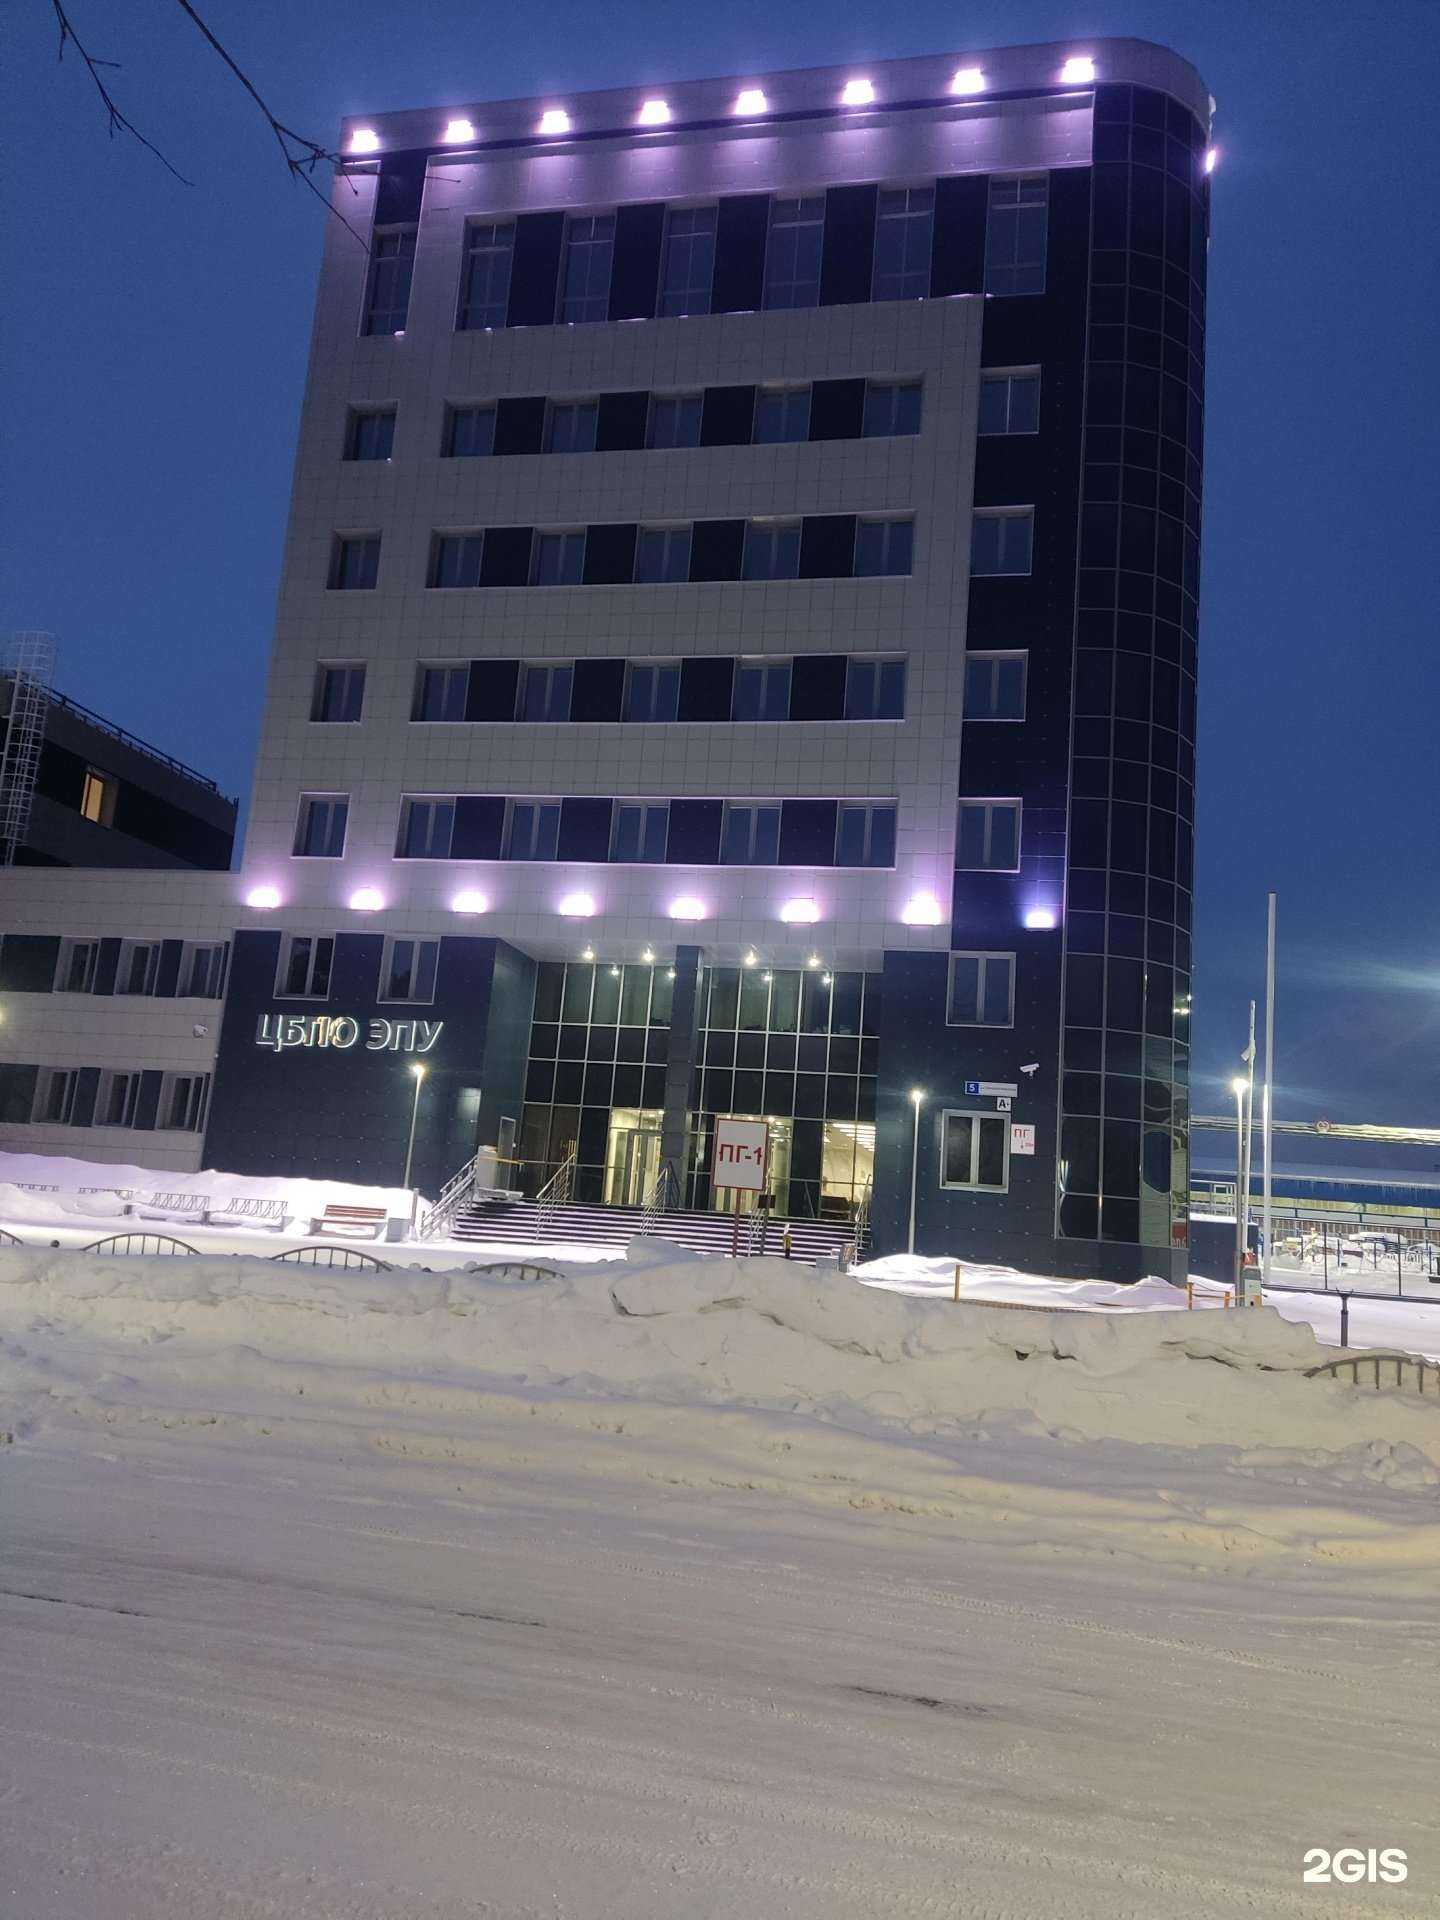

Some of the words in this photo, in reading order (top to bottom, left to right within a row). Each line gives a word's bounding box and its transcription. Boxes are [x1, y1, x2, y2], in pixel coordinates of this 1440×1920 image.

[256, 1014, 359, 1052] ЦБПО
[366, 1018, 444, 1052] ЭПУ
[969, 1083, 976, 1092] 5
[1014, 1128, 1031, 1138] ПГ
[719, 1143, 762, 1165] ПГ-1
